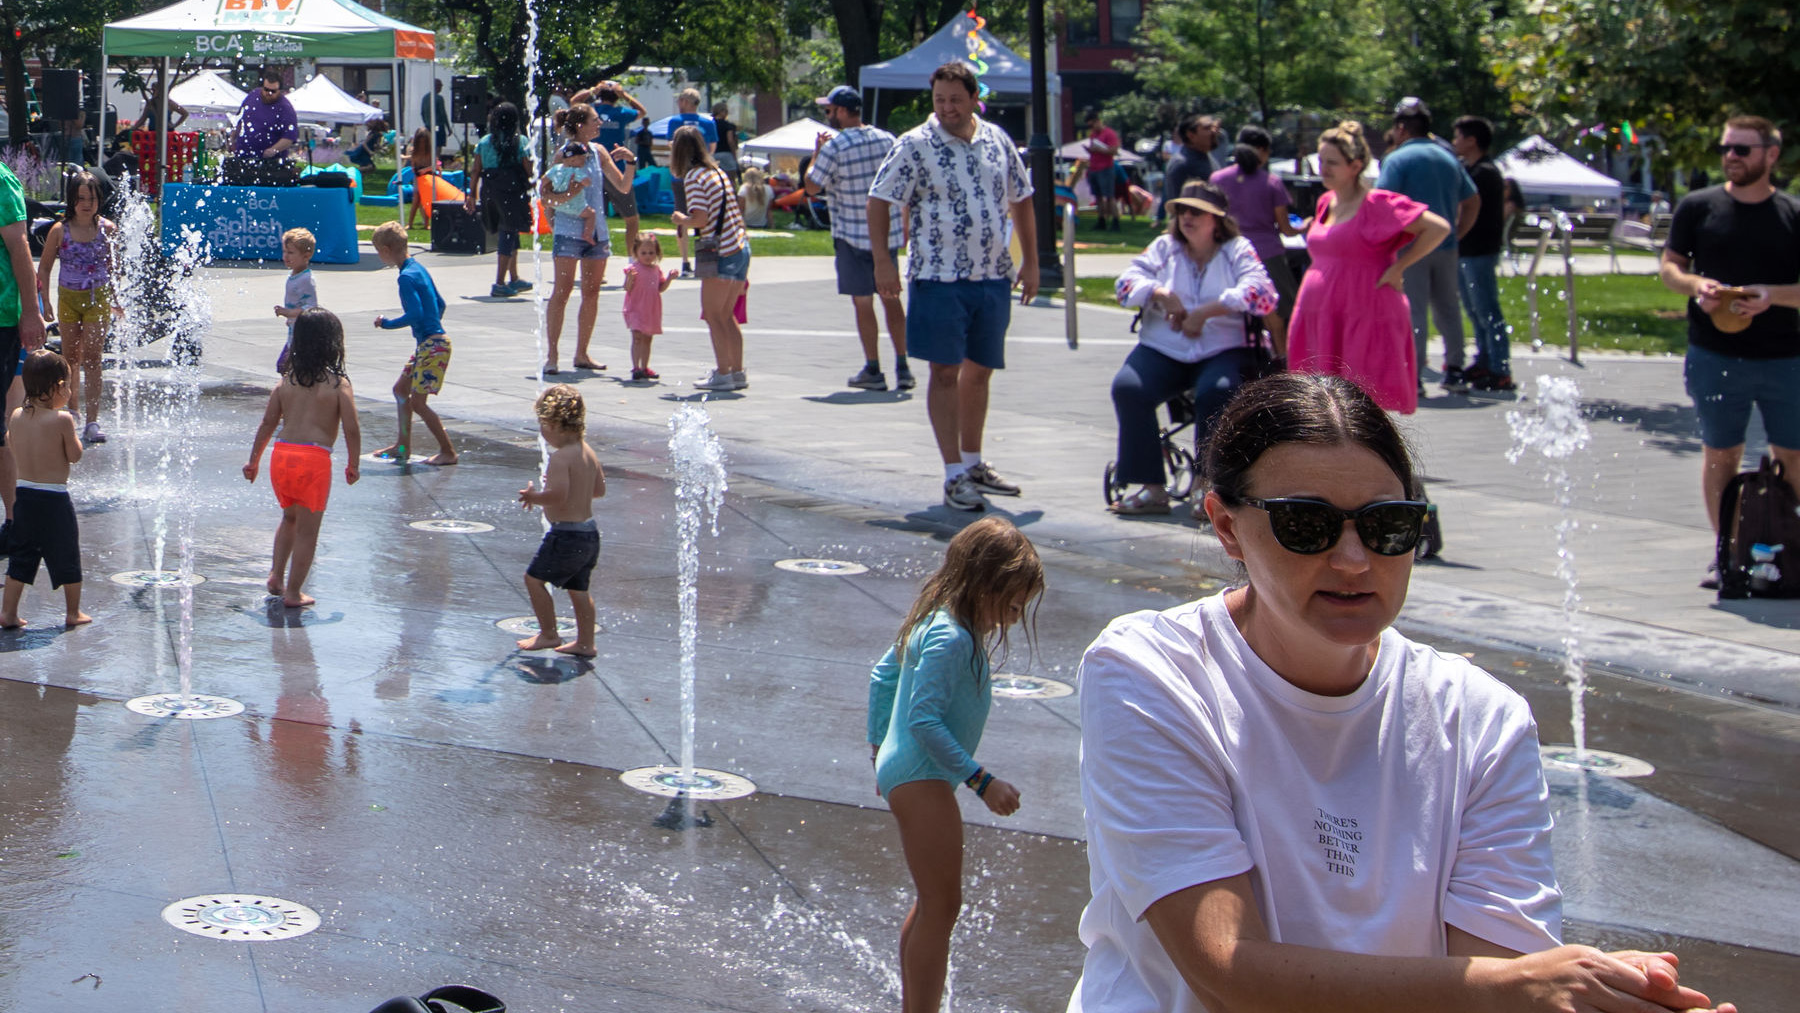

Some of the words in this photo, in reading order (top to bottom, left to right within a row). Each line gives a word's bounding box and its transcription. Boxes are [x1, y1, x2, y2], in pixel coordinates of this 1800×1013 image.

[223, 11, 292, 24] MKT
[196, 35, 240, 52] BCA
[248, 199, 279, 210] BCA
[215, 207, 283, 244] Splash
[208, 230, 278, 248] Dance
[1313, 820, 1362, 841] NOTHING
[1319, 834, 1360, 854] BETTER
[1324, 848, 1355, 865] THAN
[1326, 861, 1355, 877] THIS
